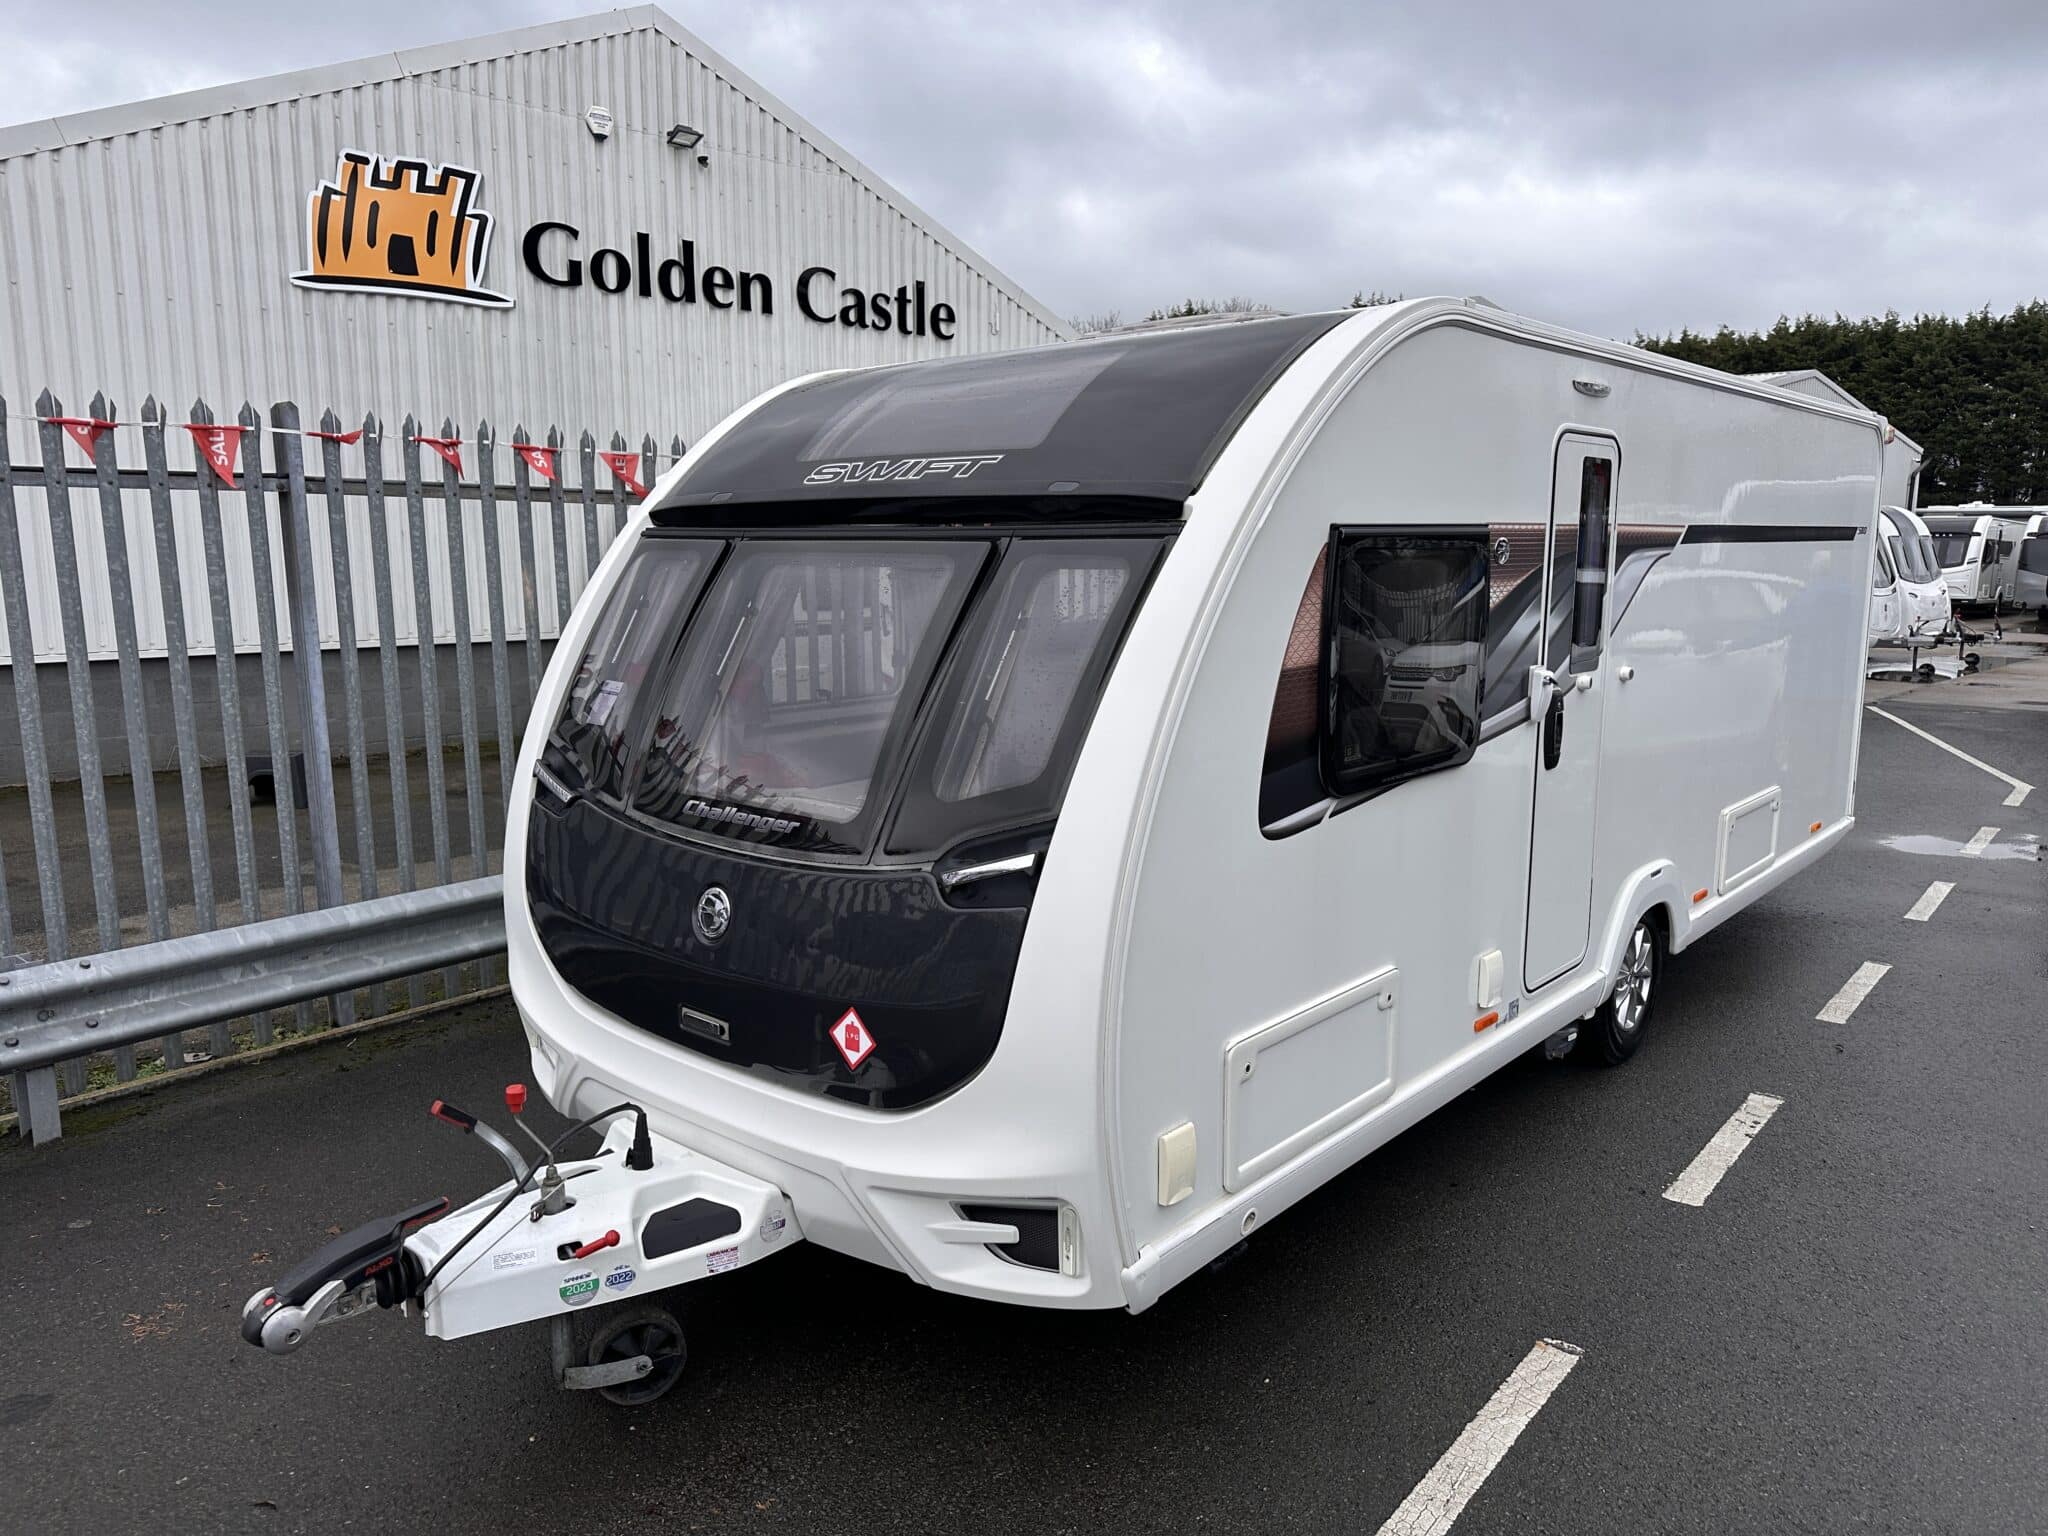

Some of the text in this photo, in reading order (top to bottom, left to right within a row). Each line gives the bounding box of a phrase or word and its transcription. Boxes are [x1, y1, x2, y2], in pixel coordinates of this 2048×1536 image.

[522, 221, 956, 340] Golden Castle
[209, 428, 229, 466] SAL
[803, 454, 1005, 484] SWIFT
[682, 799, 800, 833] Challenger
[566, 1281, 594, 1296] 2023
[606, 1271, 633, 1286] 2022
